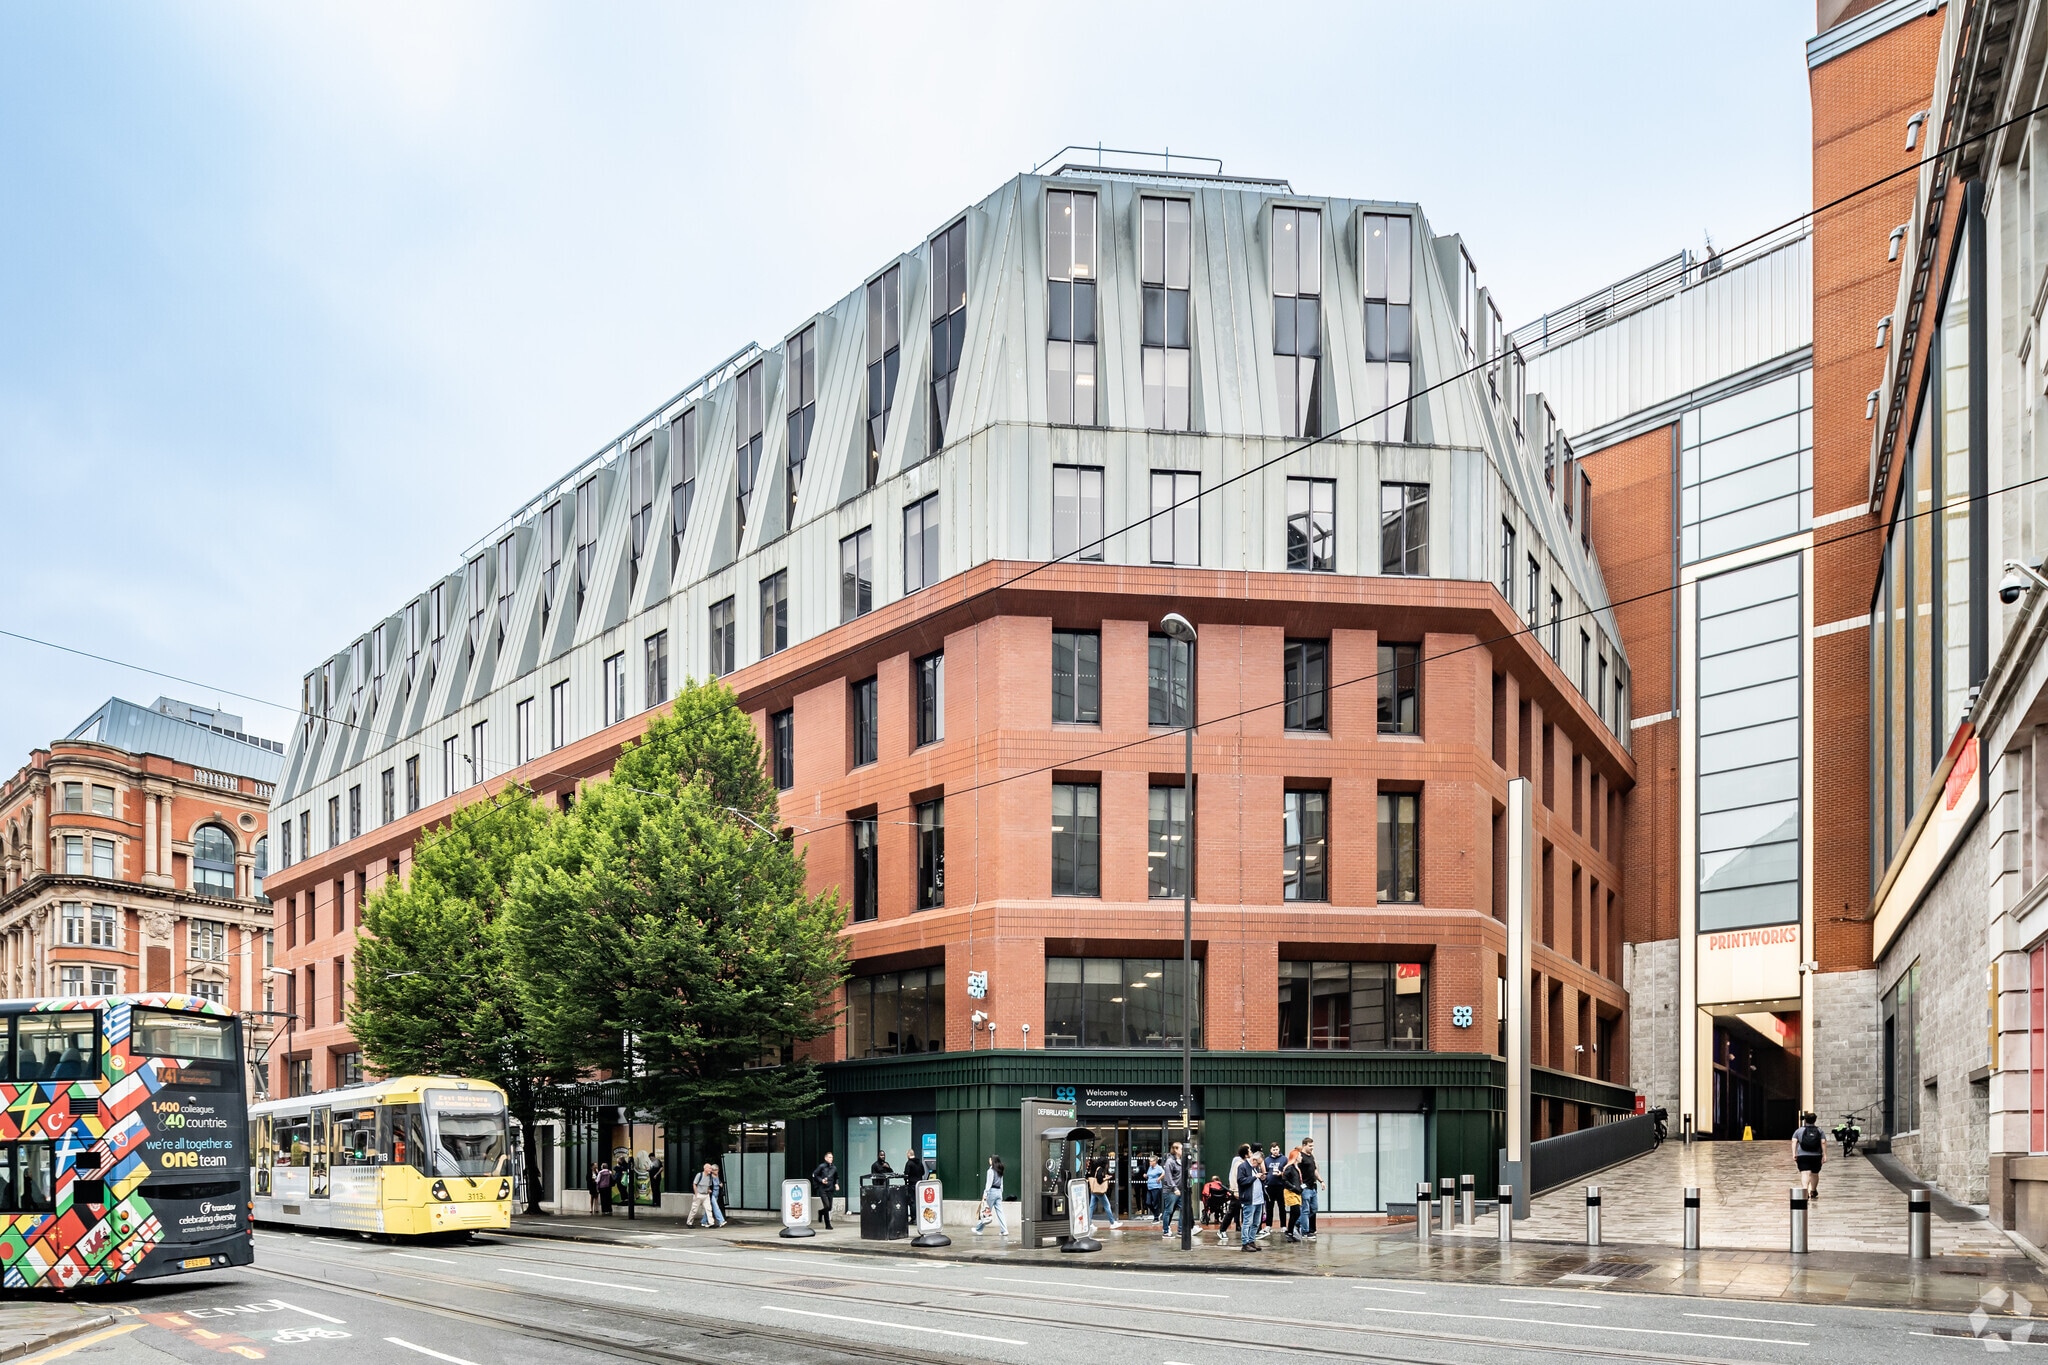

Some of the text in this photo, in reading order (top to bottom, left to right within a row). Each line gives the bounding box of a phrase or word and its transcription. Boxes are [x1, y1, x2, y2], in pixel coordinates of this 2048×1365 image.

[1709, 927, 1797, 951] PRINTWORKS
[1086, 1089, 1128, 1097] Welcome to
[152, 1101, 215, 1115] 1,400 colleagues
[1086, 1099, 1128, 1108] Corporation
[1129, 1099, 1155, 1107] Street's
[1156, 1099, 1178, 1108] Co-op
[1037, 1108, 1069, 1117] DEFIBRILLATOR
[186, 1117, 228, 1128] countries
[146, 1137, 233, 1152] we're all together as
[161, 1151, 227, 1168] one team
[211, 1203, 236, 1212] transdev
[179, 1212, 236, 1225] celebrating diversity
[184, 1302, 286, 1319] END
